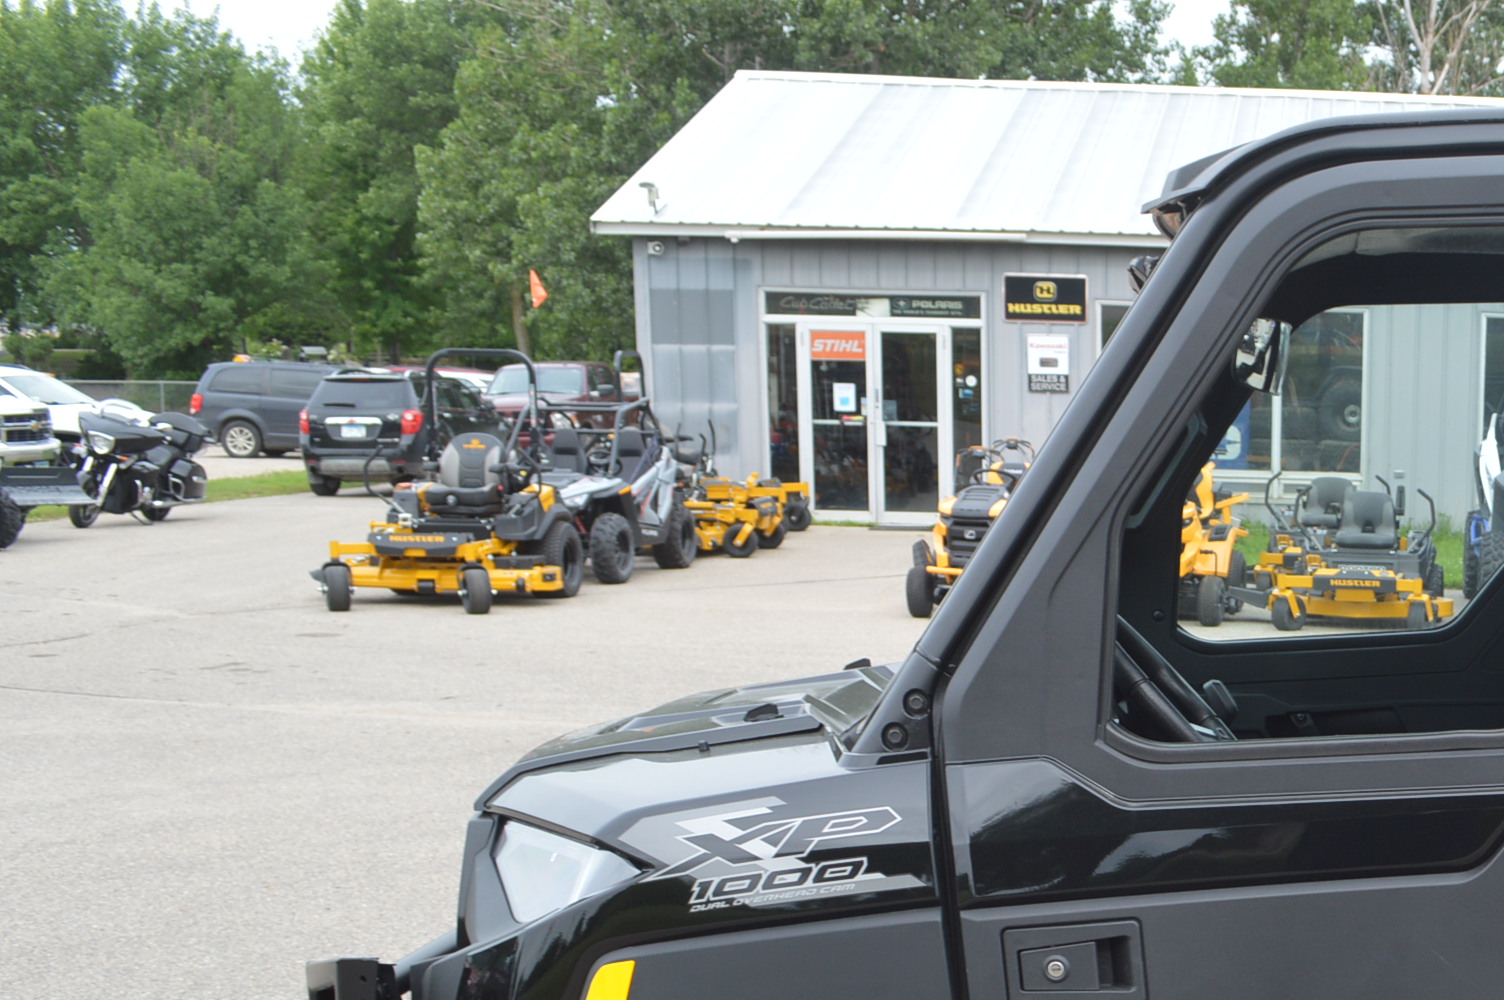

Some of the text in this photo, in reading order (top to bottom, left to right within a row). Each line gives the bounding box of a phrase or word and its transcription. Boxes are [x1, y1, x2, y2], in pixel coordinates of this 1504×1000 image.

[911, 299, 963, 310] POLARIS
[1007, 302, 1083, 315] HUSTLER
[811, 339, 864, 353] STIHL
[1030, 374, 1058, 382] SALES
[1030, 382, 1067, 391] SERVICE
[1329, 578, 1381, 587] HUSTLER
[653, 805, 903, 880] XP
[688, 856, 868, 905] 1000
[688, 882, 856, 913] DUAL OVERHEAD CAM
